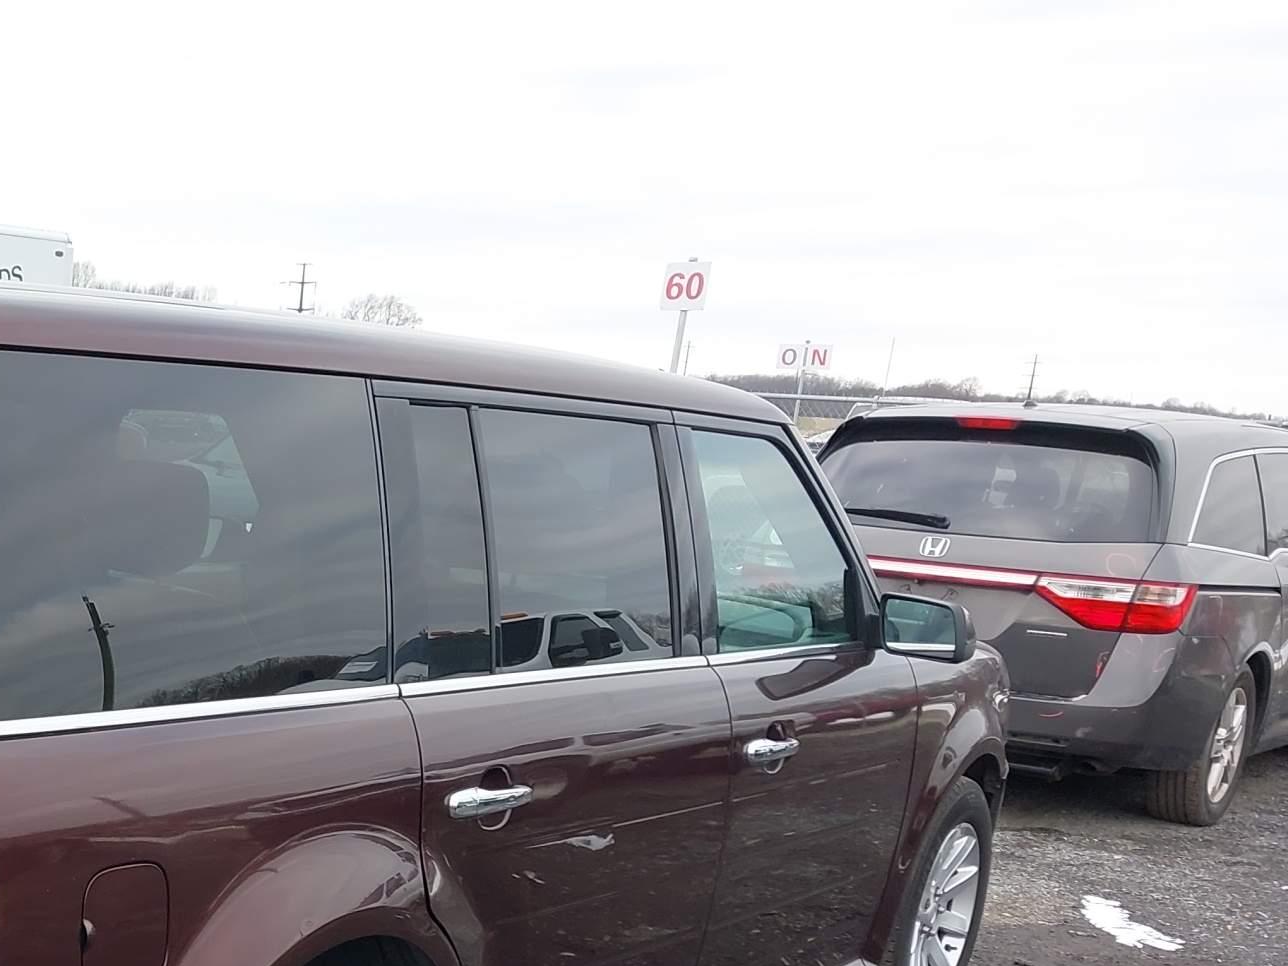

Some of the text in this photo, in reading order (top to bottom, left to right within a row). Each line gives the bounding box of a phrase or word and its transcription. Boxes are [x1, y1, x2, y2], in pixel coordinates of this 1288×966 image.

[665, 271, 705, 301] 60
[781, 348, 828, 366] O N
